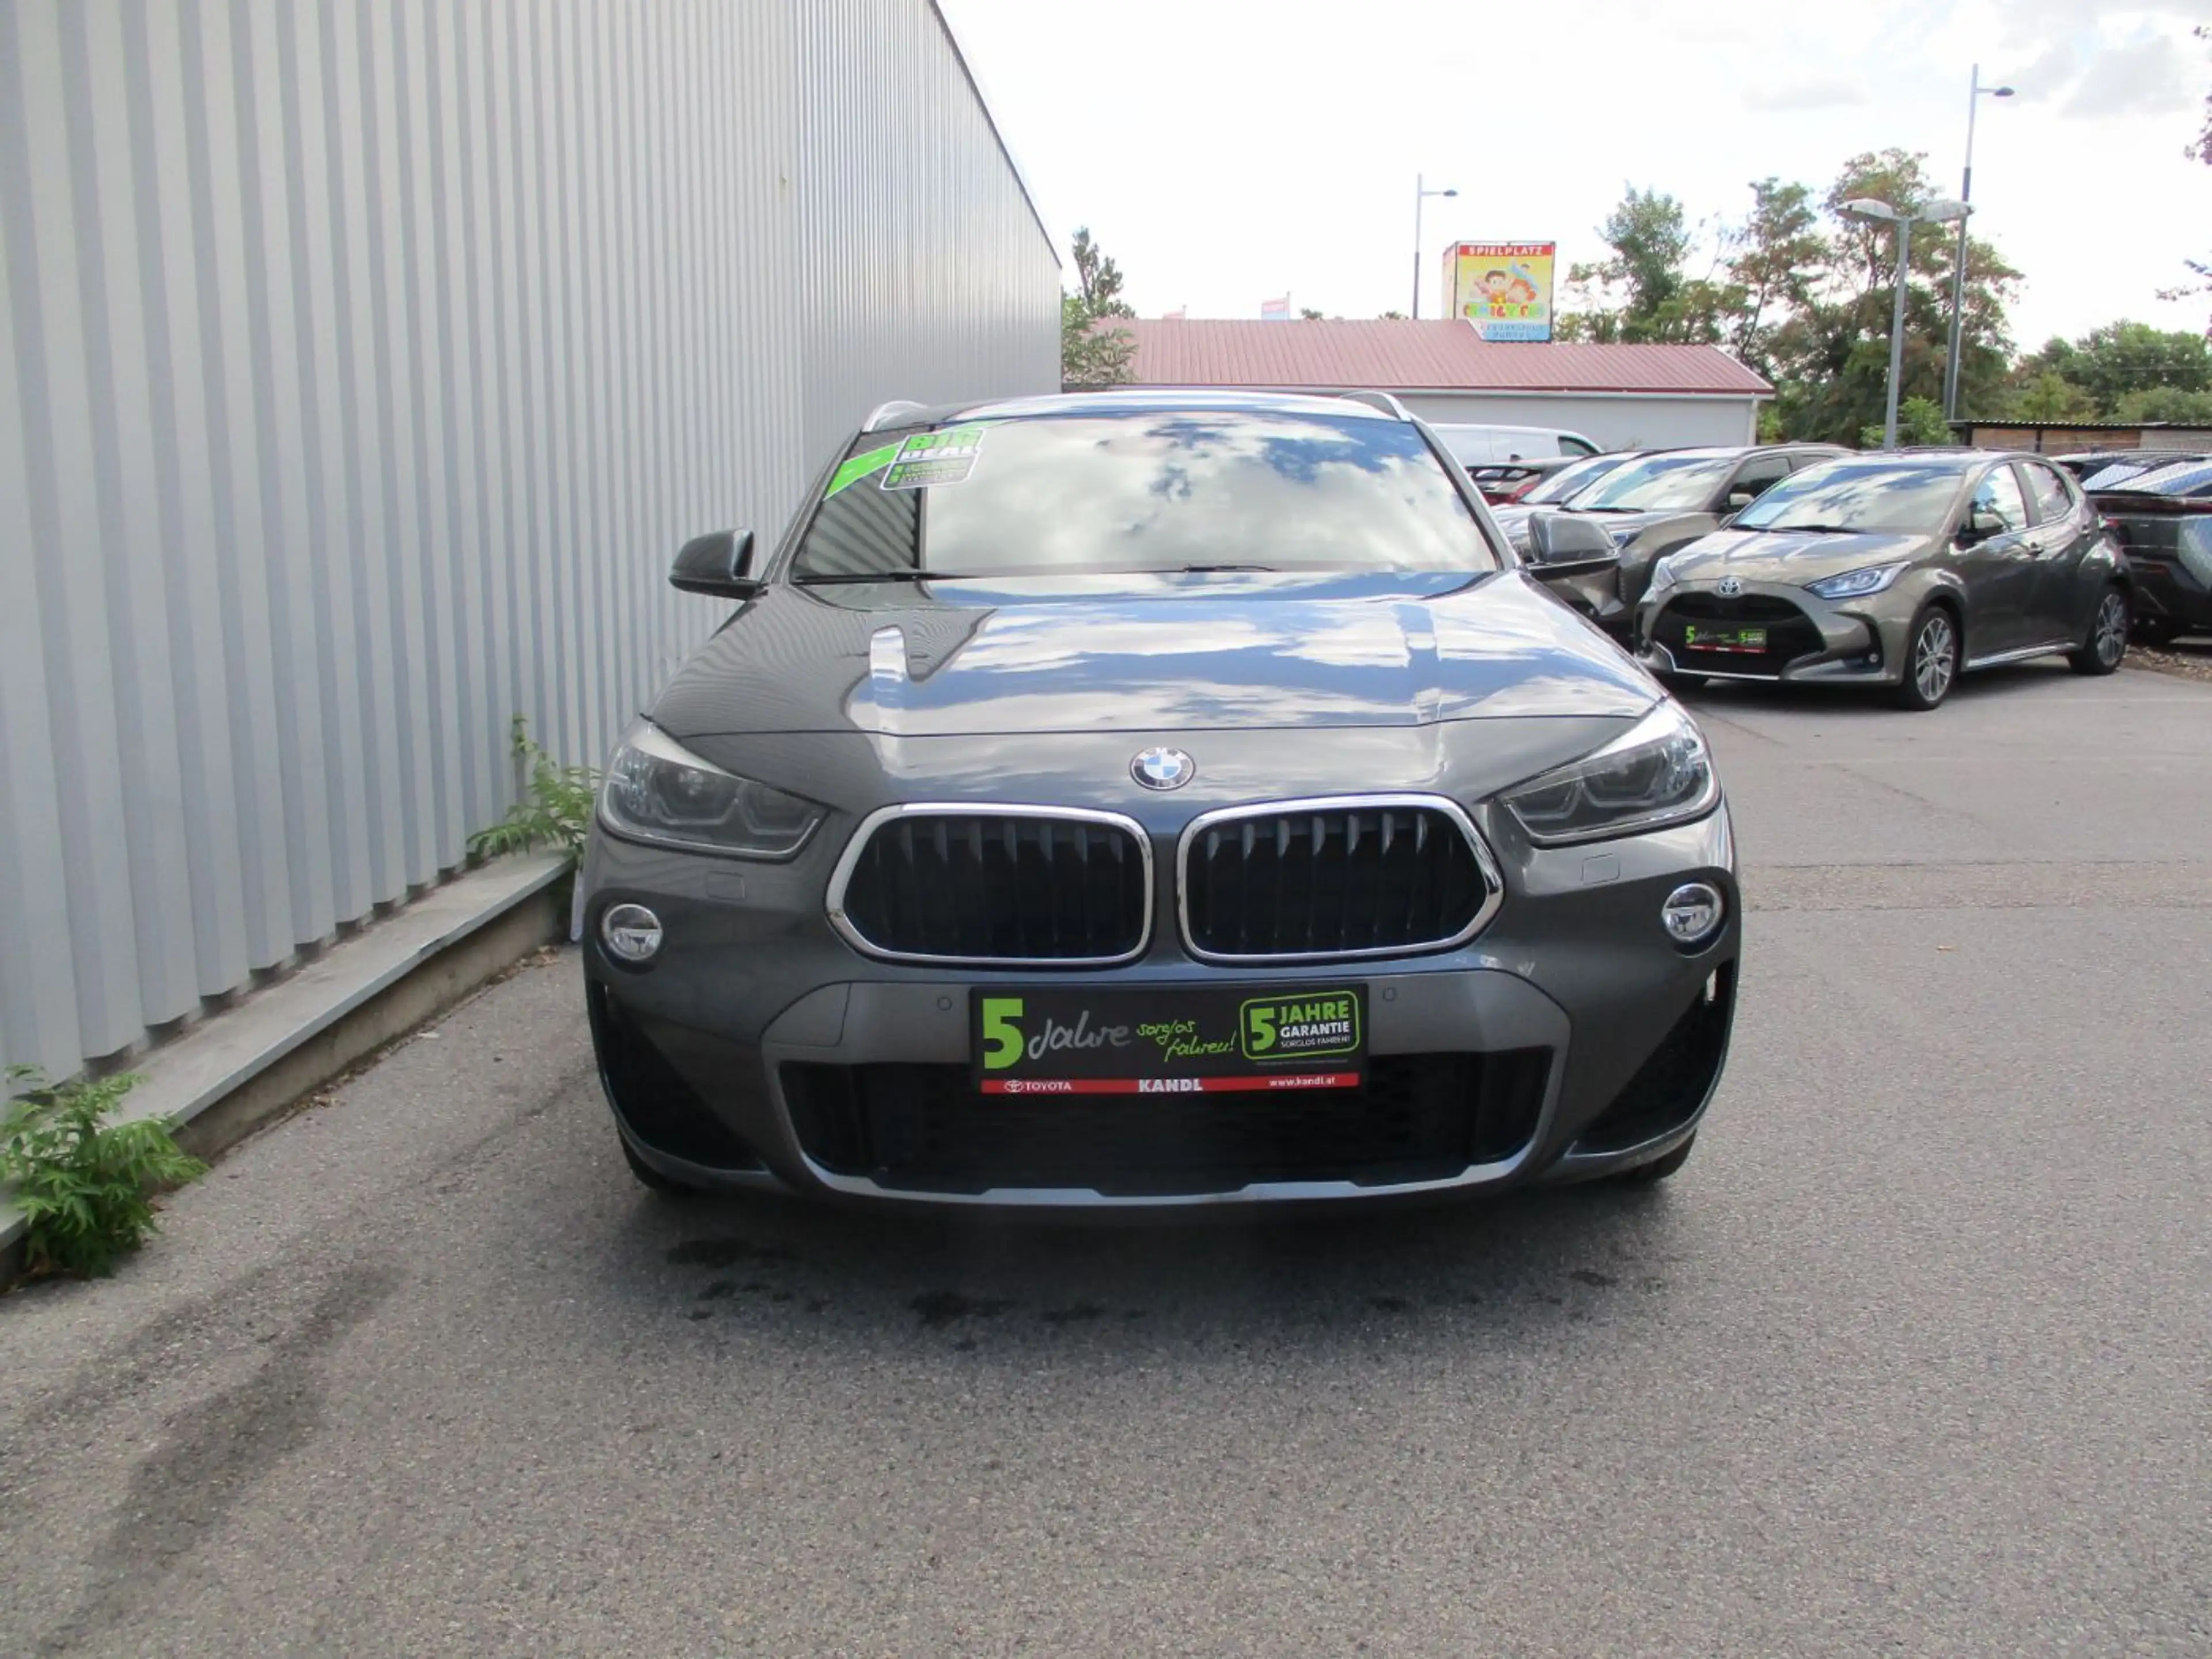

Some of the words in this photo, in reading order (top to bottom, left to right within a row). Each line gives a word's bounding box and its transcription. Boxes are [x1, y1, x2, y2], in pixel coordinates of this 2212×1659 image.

[1469, 246, 1541, 256] SPIELPLATZ
[1687, 626, 1695, 644] 5
[983, 998, 1024, 1069] 5
[1137, 1020, 1195, 1046] sorglos
[1250, 1007, 1276, 1051] 5
[1279, 1000, 1349, 1025] JAHRE
[1280, 1021, 1350, 1037] GARANTIE
[1025, 1081, 1072, 1090] TOYOTA
[1138, 1078, 1203, 1093] KANDL
[1269, 1077, 1335, 1086] www.kandl.at
